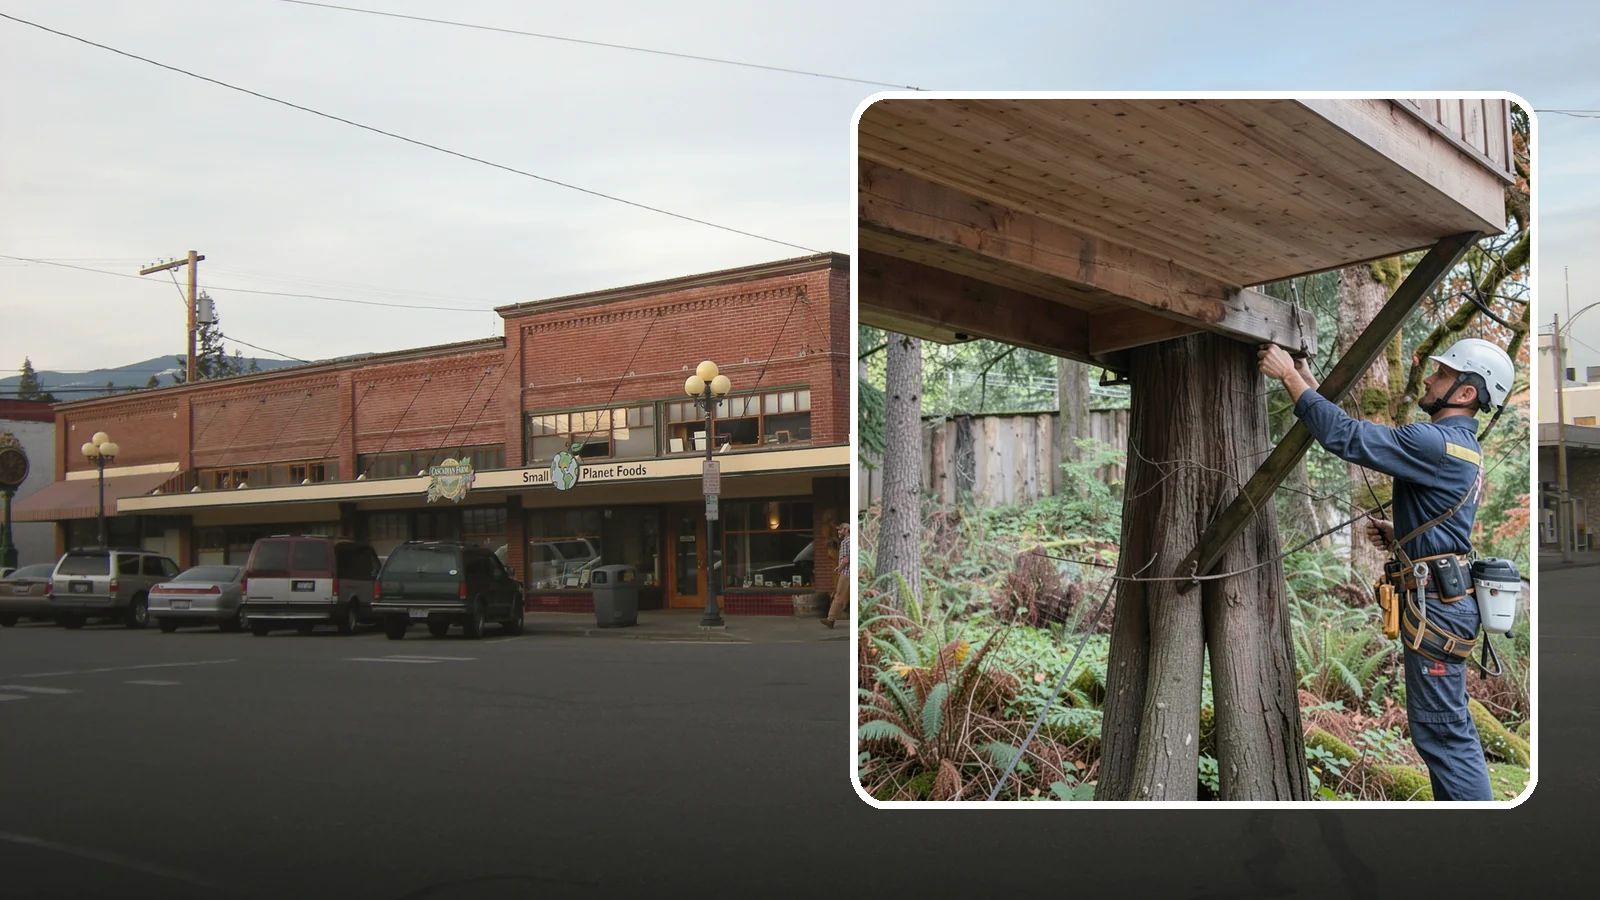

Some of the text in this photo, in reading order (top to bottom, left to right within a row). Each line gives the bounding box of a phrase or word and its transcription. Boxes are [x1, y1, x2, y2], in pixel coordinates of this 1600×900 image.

[523, 464, 647, 483] Small Planet Foods
